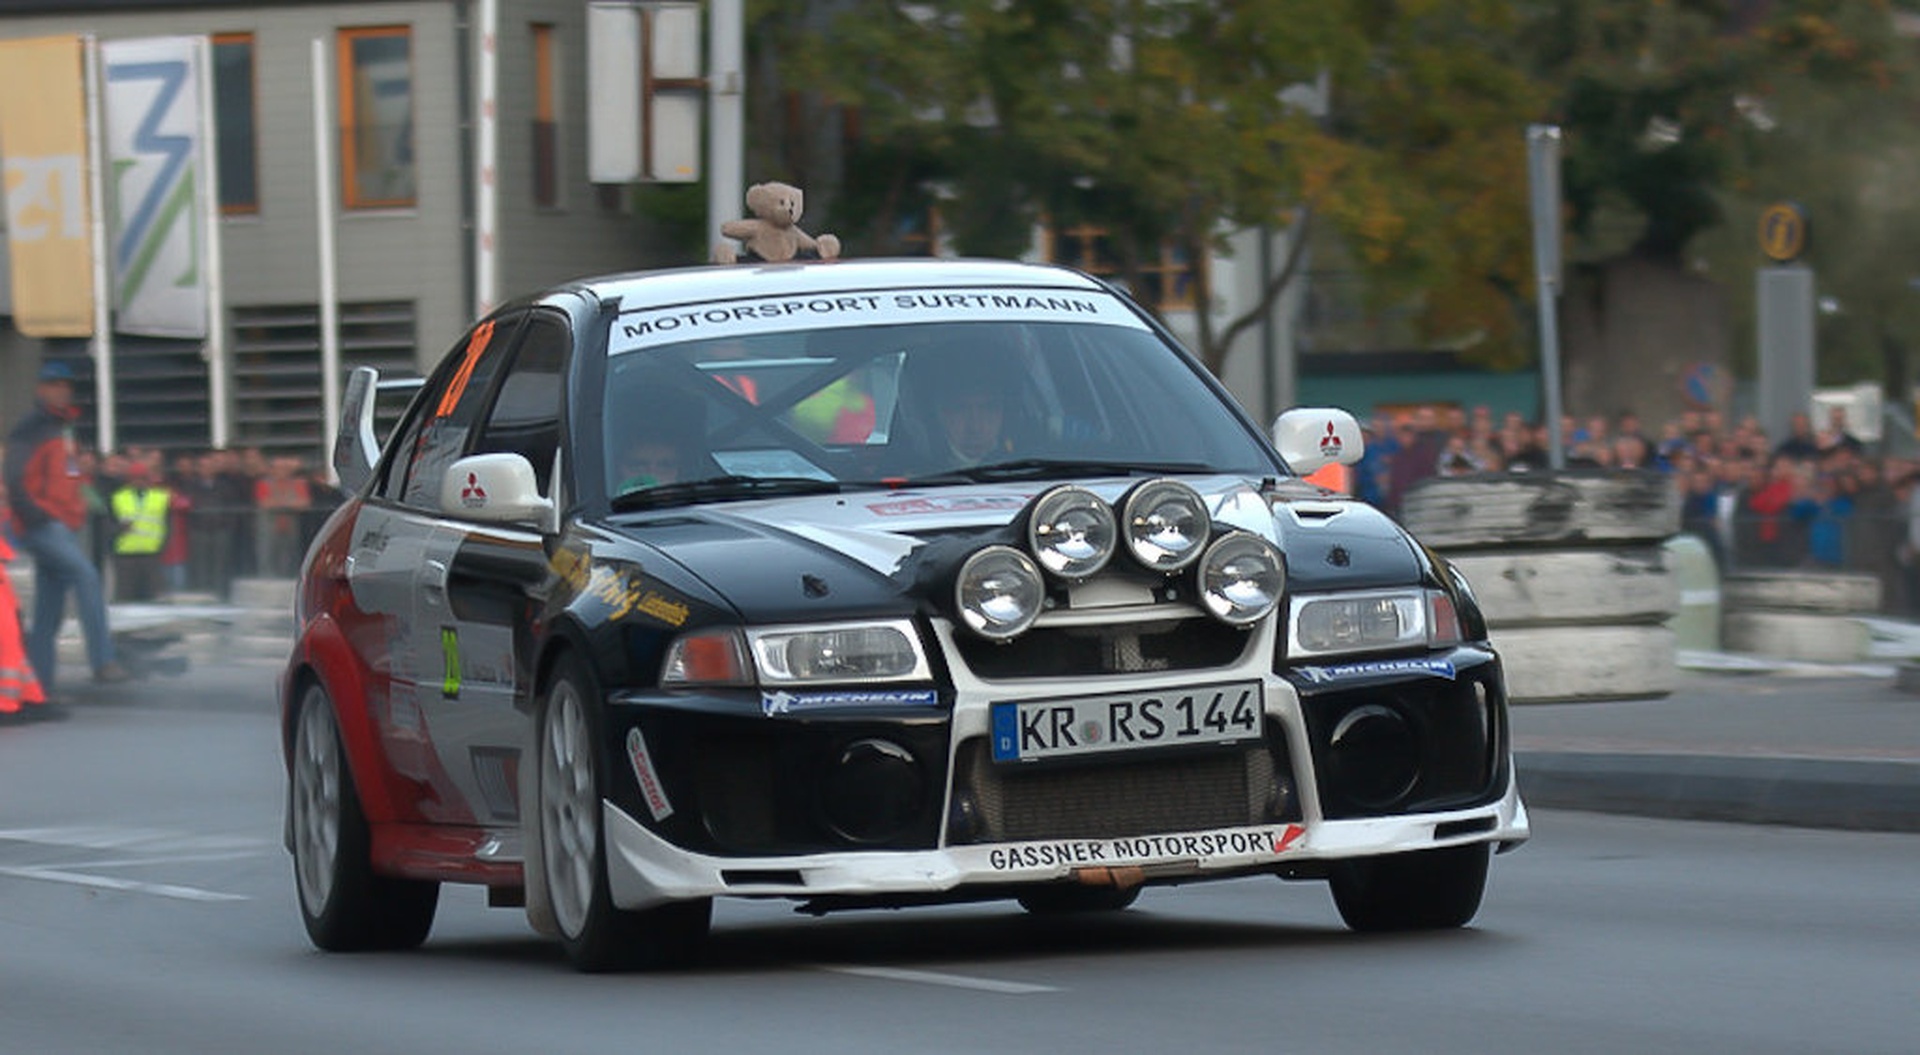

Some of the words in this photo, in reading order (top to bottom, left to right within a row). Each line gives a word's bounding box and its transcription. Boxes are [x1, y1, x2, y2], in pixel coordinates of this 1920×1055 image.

[623, 296, 881, 338] MOTORSPORT
[894, 294, 1098, 314] SURTMANN
[1333, 660, 1449, 676] MICHELIN
[1001, 737, 1011, 750] D
[1020, 706, 1078, 751] KR
[1109, 698, 1166, 742] RS
[1174, 690, 1256, 737] 144
[989, 841, 1106, 871] GASSNER
[1112, 830, 1276, 859] MOTORSPORT
